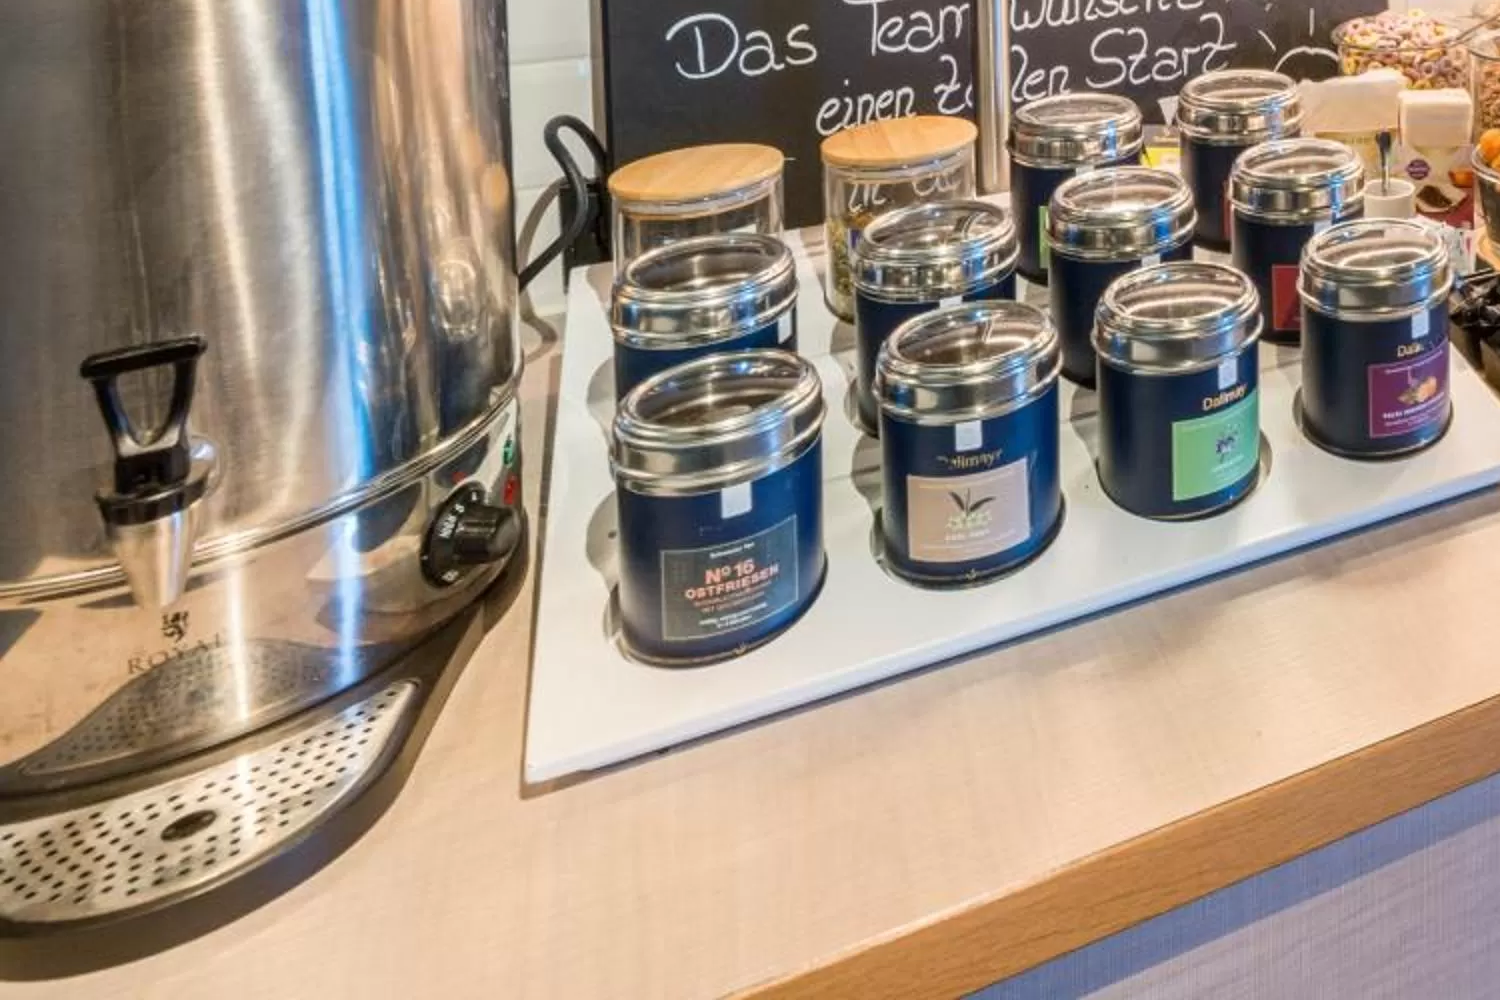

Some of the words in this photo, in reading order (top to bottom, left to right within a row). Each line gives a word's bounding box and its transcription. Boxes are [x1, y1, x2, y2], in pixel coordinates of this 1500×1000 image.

[666, 12, 818, 79] Das
[816, 79, 917, 136] einen
[1085, 12, 1237, 89] Start
